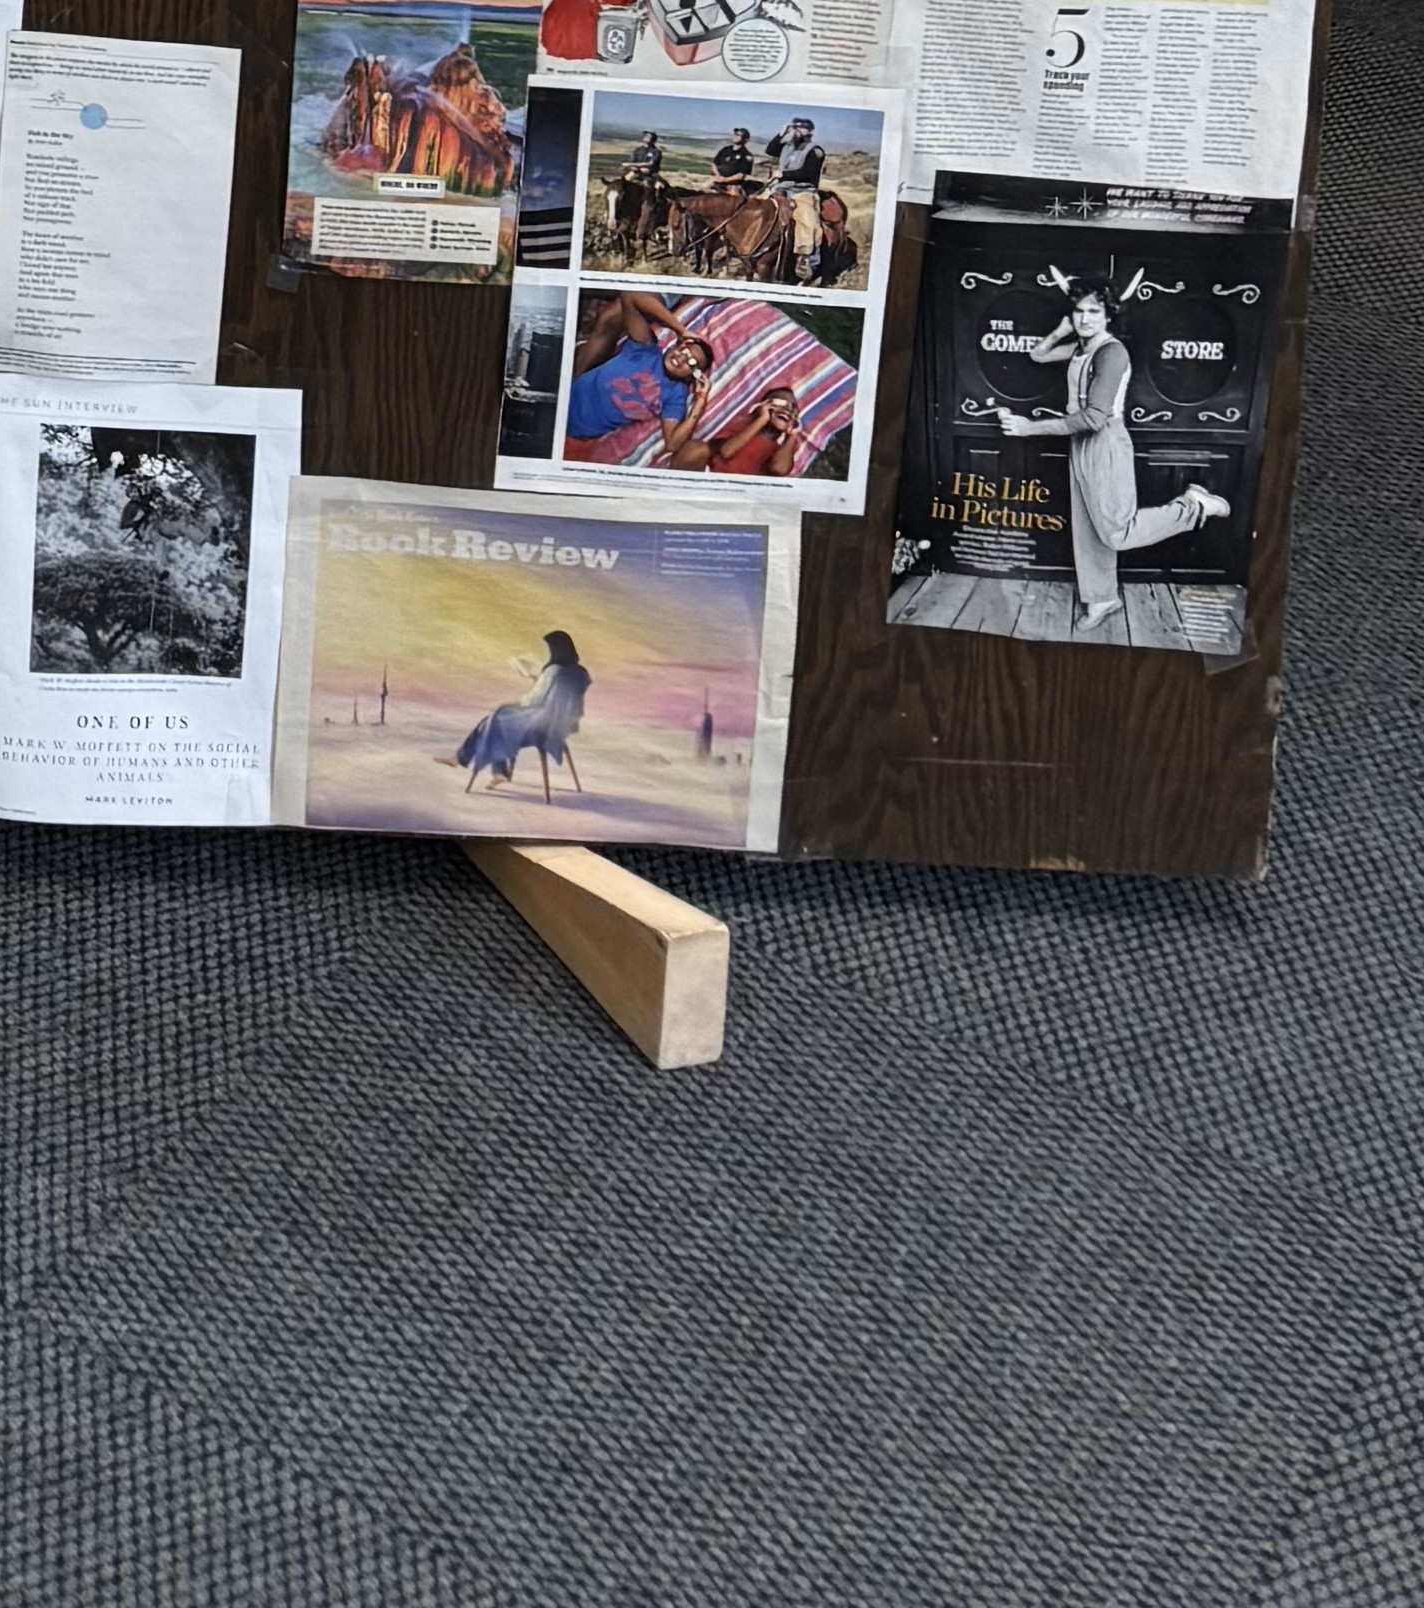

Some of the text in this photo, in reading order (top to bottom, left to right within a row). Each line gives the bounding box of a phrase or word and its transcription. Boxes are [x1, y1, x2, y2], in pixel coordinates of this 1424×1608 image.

[1046, 9, 1090, 68] 5
[990, 320, 1013, 331] THE
[982, 334, 1043, 353] COME
[1161, 340, 1224, 359] STORE
[950, 472, 1051, 504] His Life
[931, 500, 1064, 532] in Pictures
[327, 523, 620, 570] Book Review
[76, 714, 190, 730] ONE OF US
